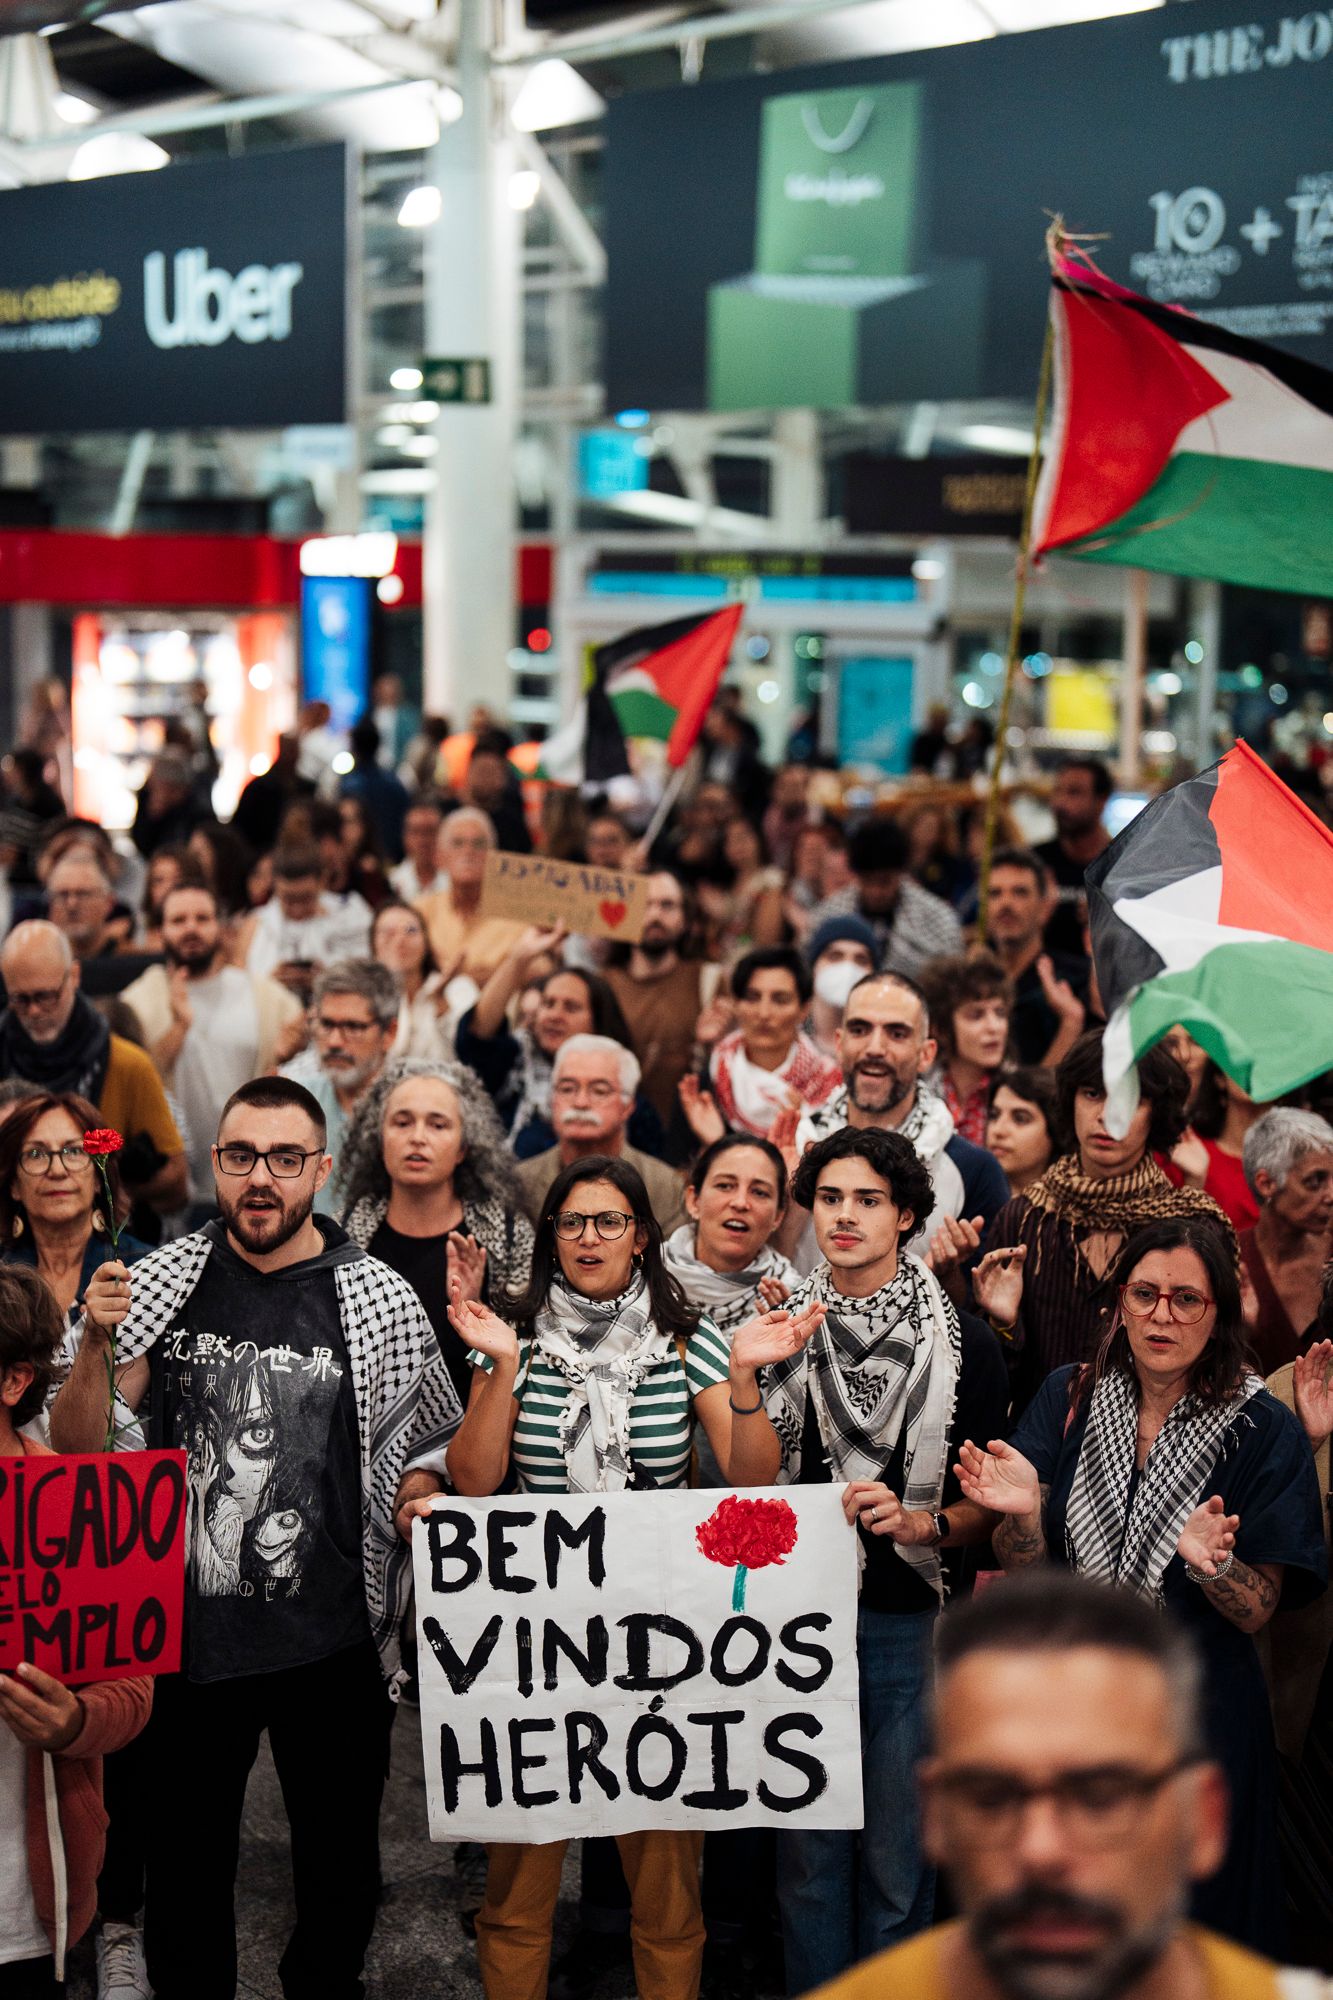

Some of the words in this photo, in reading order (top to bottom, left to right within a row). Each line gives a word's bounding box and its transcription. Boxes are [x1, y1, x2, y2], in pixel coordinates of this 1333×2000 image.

[1160, 23, 1265, 83] THE
[1264, 9, 1333, 67] JO
[1149, 185, 1226, 253] 10
[144, 247, 303, 349] Uber
[421, 1506, 607, 1594] BEM
[422, 1612, 834, 1698] VINDOS
[440, 1694, 829, 1814] HERÓIS
